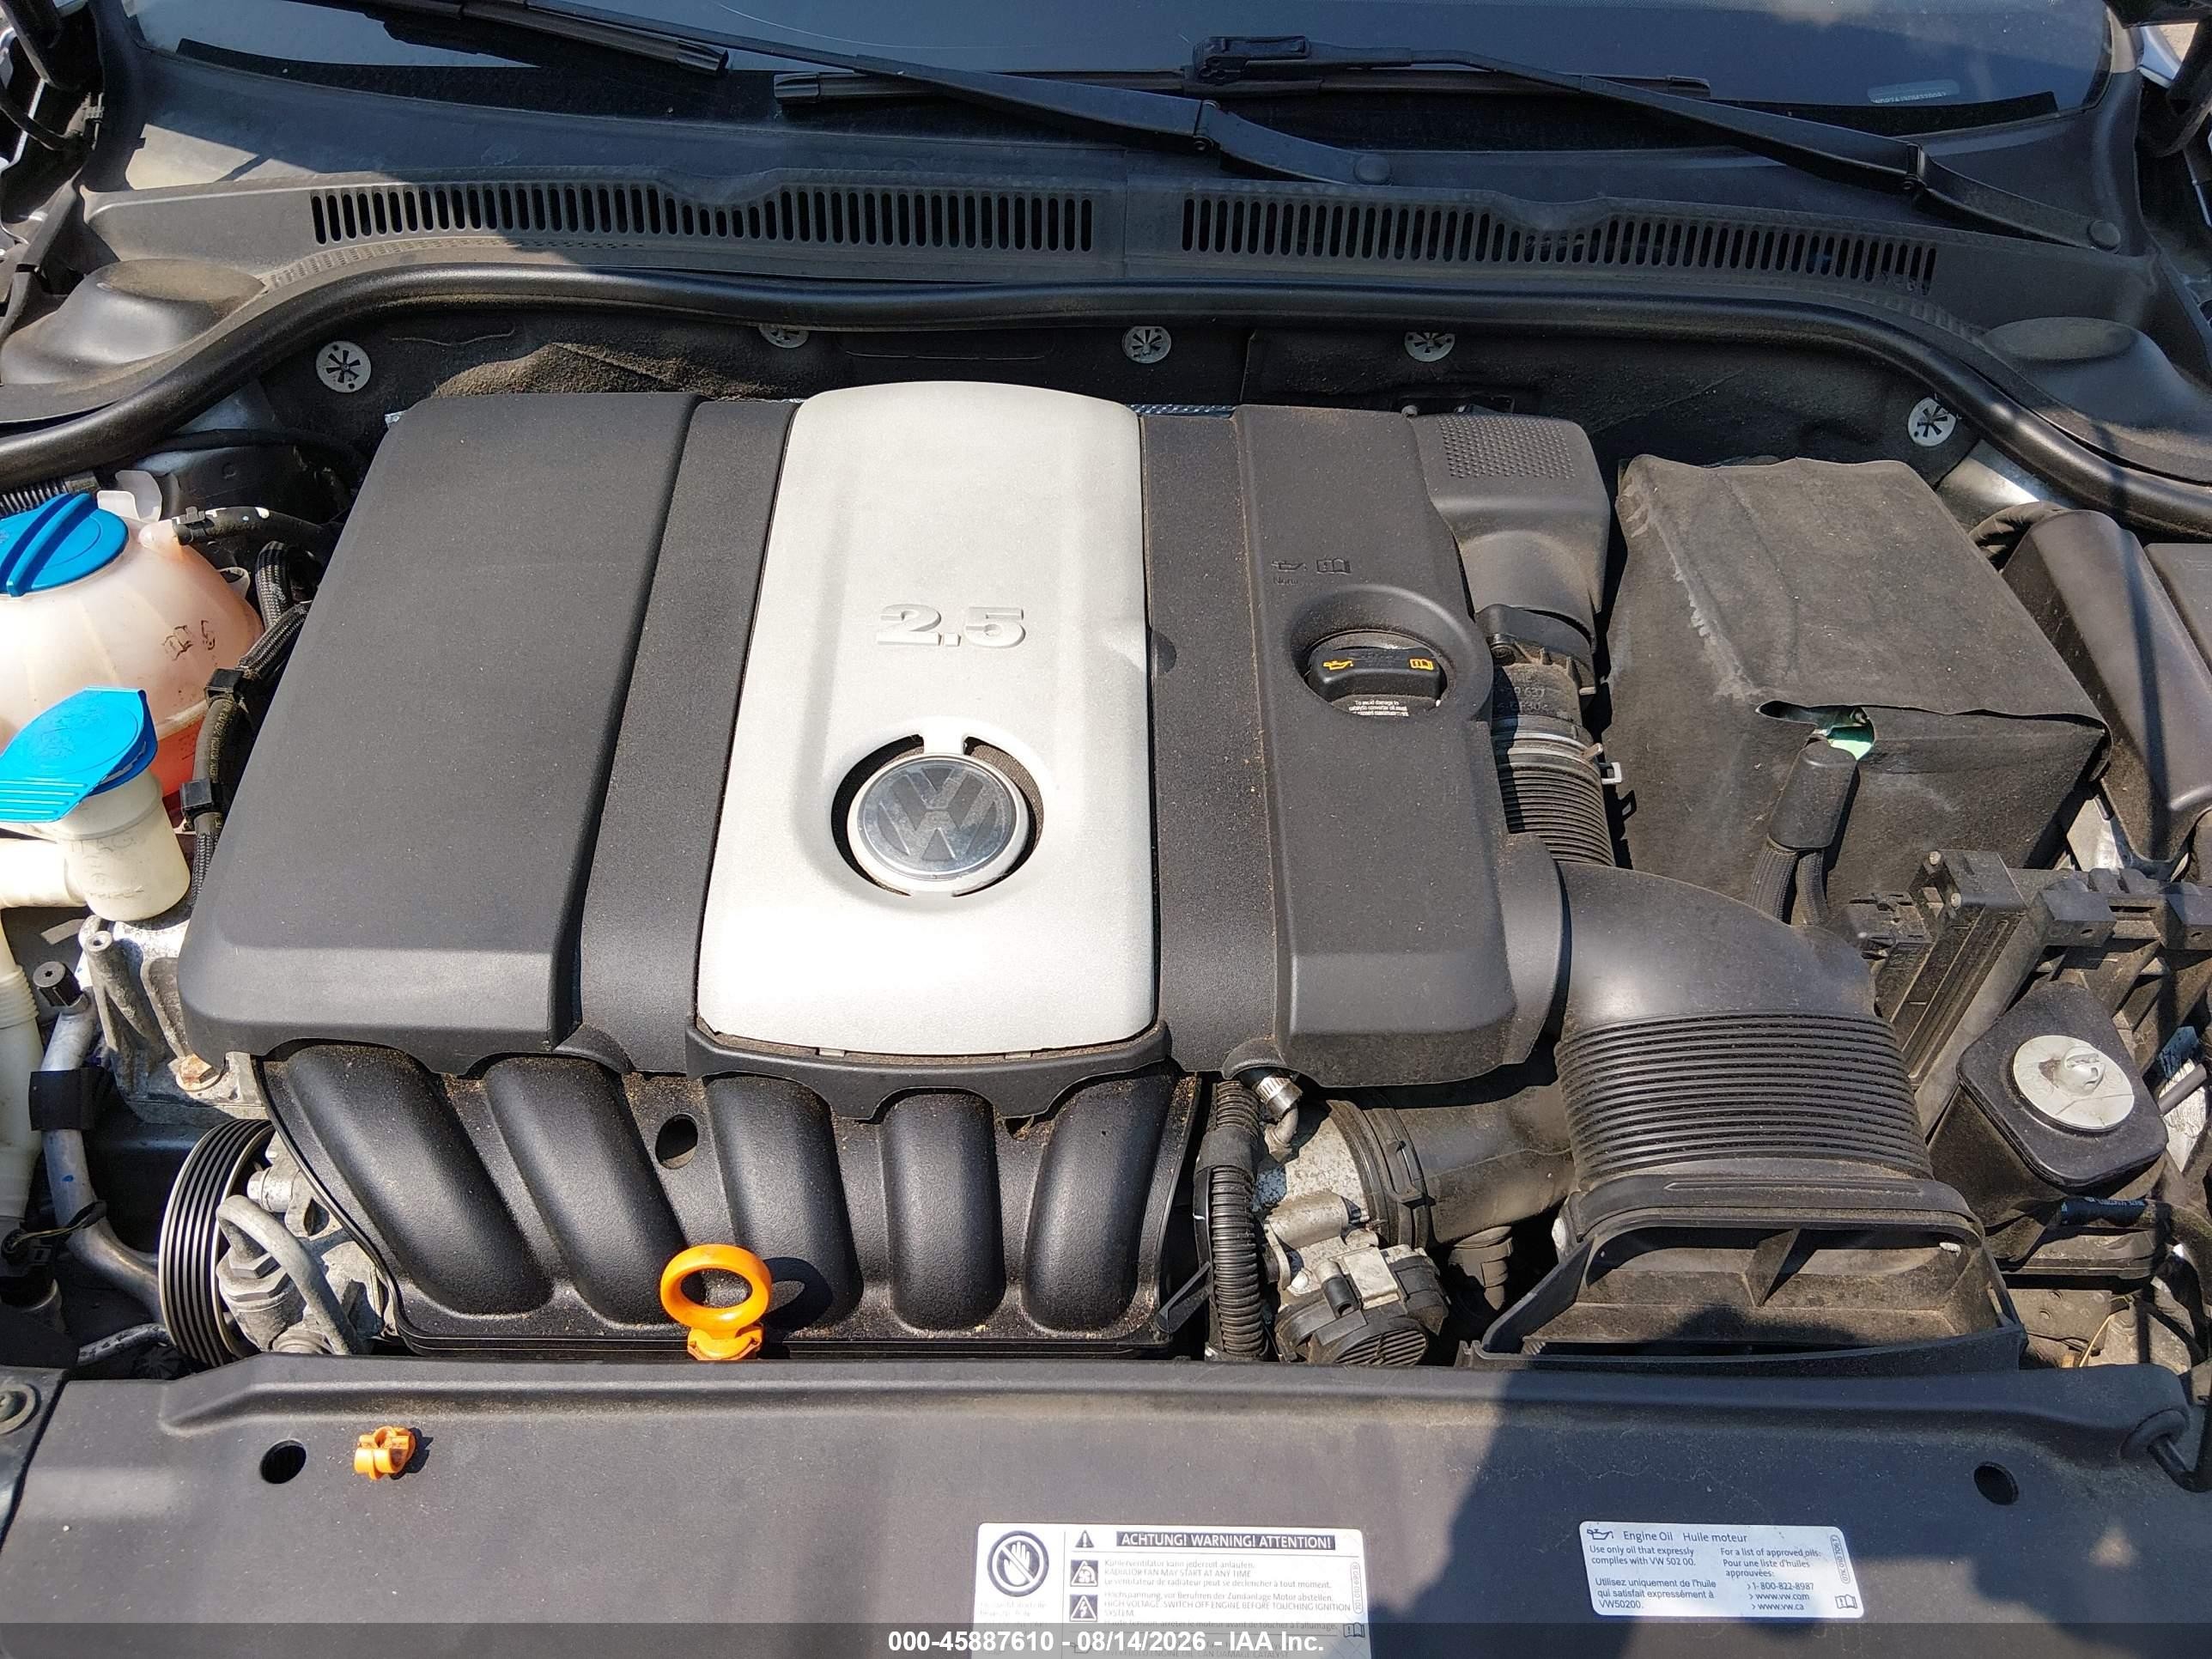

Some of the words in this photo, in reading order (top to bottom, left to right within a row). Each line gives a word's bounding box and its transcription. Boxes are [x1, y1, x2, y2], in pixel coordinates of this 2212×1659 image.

[877, 604, 1026, 649] 2.5
[1121, 1534, 1187, 1546] ACHTUNG!
[1191, 1534, 1255, 1547] WARNING!
[1259, 1536, 1331, 1548] ATTENTION!
[1623, 1531, 1656, 1542] Engine
[1660, 1532, 1673, 1540] Oil
[1683, 1533, 1708, 1541] Huile
[1711, 1534, 1747, 1542] moteur
[1607, 1546, 1624, 1555] only
[1657, 1547, 1693, 1557] expressly
[1766, 1549, 1802, 1558] approved
[1591, 1557, 1627, 1565] complies
[1595, 1577, 1626, 1586] Utilisez
[1628, 1579, 1677, 1589] uniquement
[1692, 1579, 1717, 1588] l'huile
[1597, 1589, 1610, 1598] qui
[1647, 1589, 1706, 1600] expressément
[1211, 1601, 1240, 1609] ENGINE
